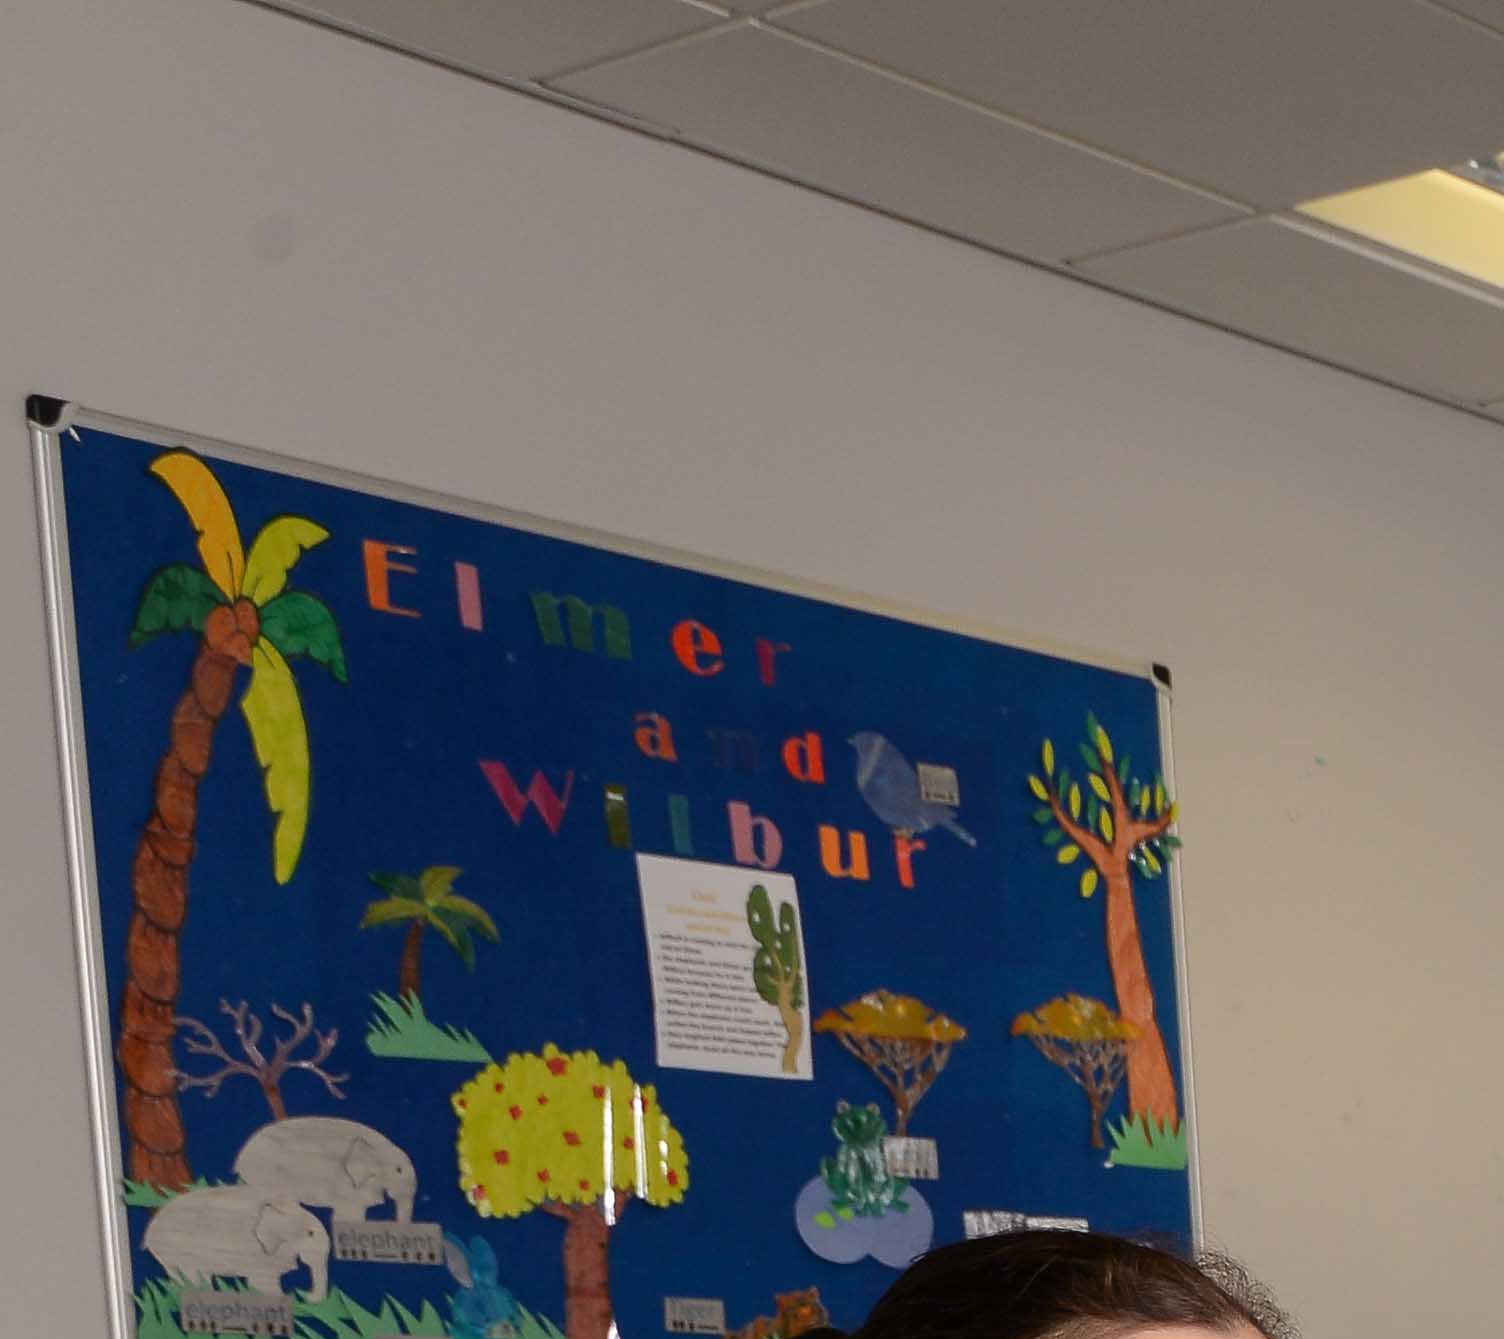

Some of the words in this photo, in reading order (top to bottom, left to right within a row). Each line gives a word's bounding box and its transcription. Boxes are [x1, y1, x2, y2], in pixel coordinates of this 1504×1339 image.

[361, 538, 793, 690] Elmer
[633, 709, 826, 786] and
[478, 760, 927, 889] Wilbur
[337, 1231, 435, 1256] elephant
[185, 1299, 288, 1326] elephant
